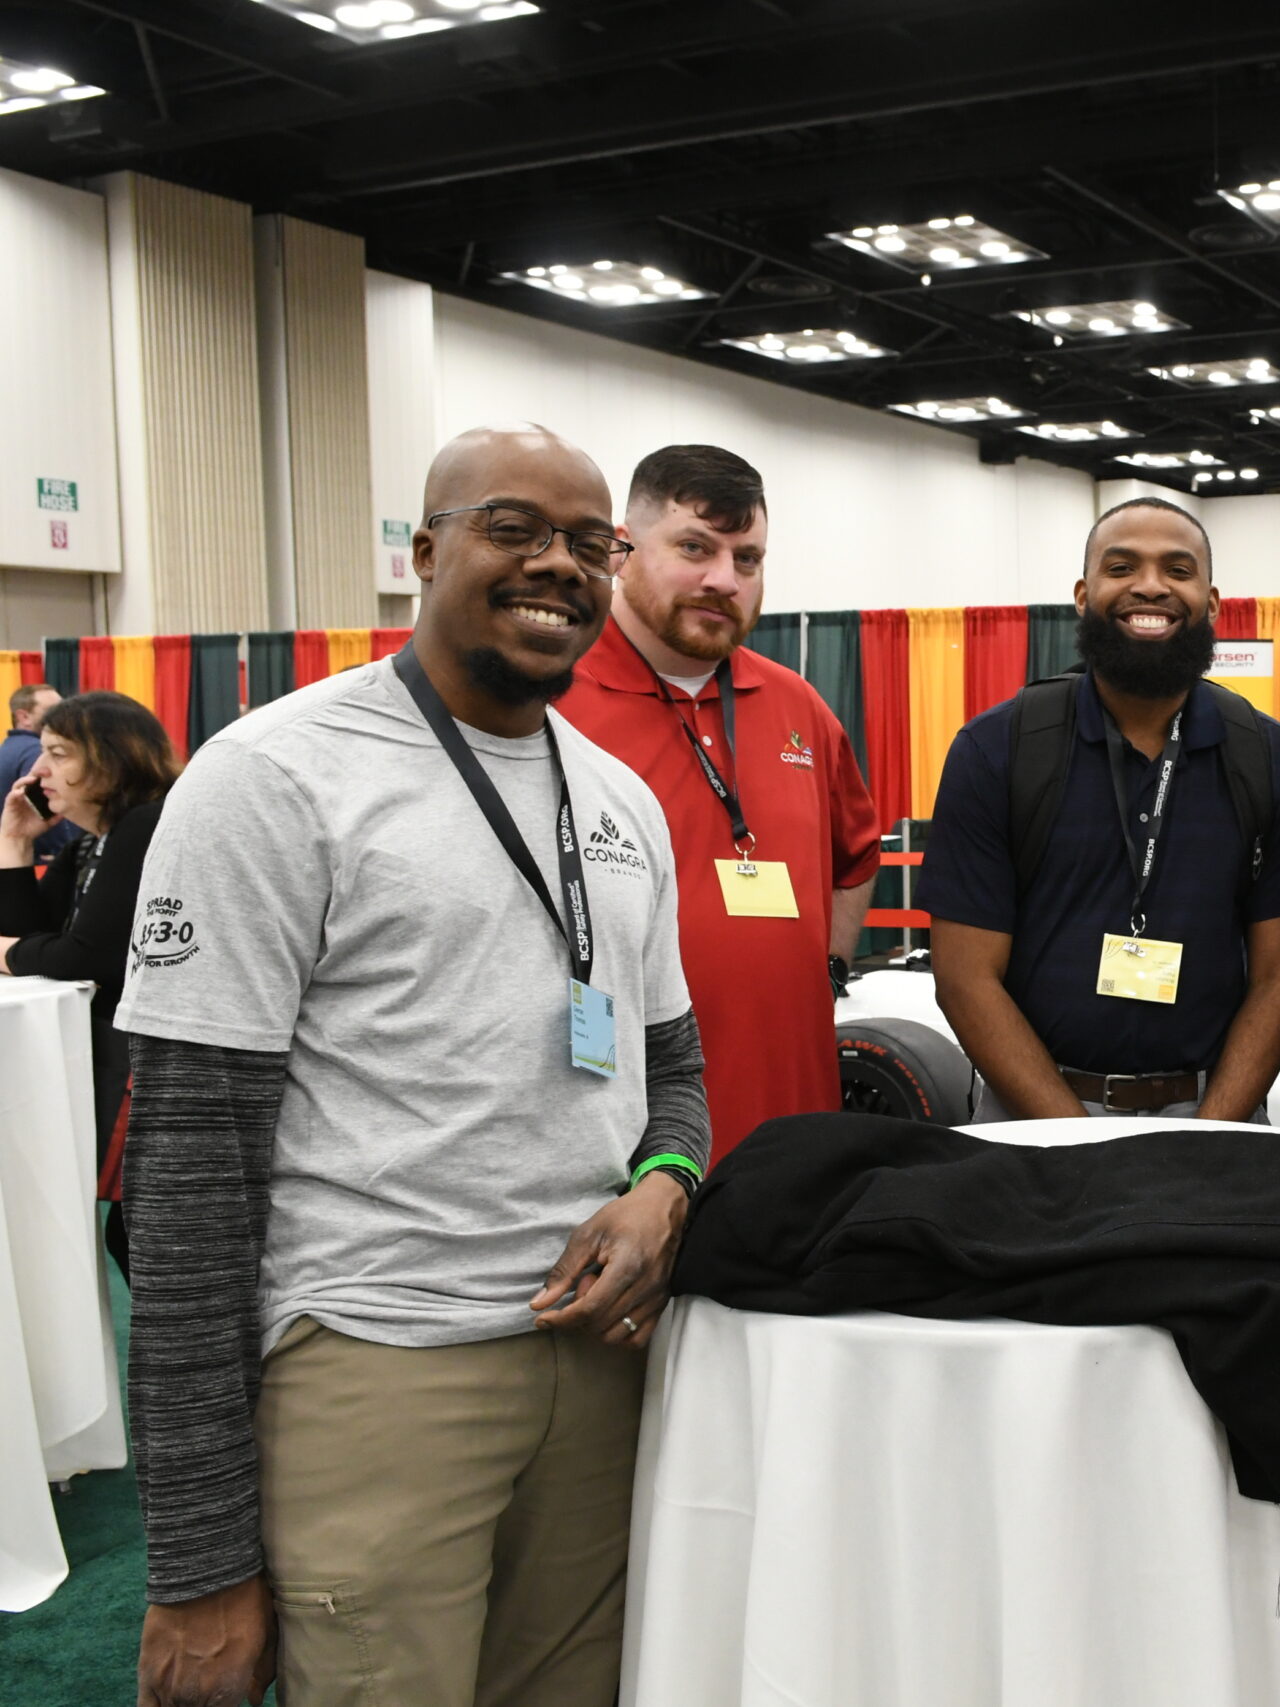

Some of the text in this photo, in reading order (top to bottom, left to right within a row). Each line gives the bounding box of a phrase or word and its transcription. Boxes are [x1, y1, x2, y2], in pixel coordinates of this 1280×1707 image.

[43, 479, 71, 495] FIRE
[1162, 760, 1172, 781] BCSP
[561, 805, 574, 853] BCSP.ORG
[584, 848, 648, 871] CONAGRA
[1143, 838, 1155, 877] BCSP.ORG
[147, 897, 183, 910] SPREAD
[163, 945, 200, 967] GROWTH
[577, 930, 589, 961] BCSP
